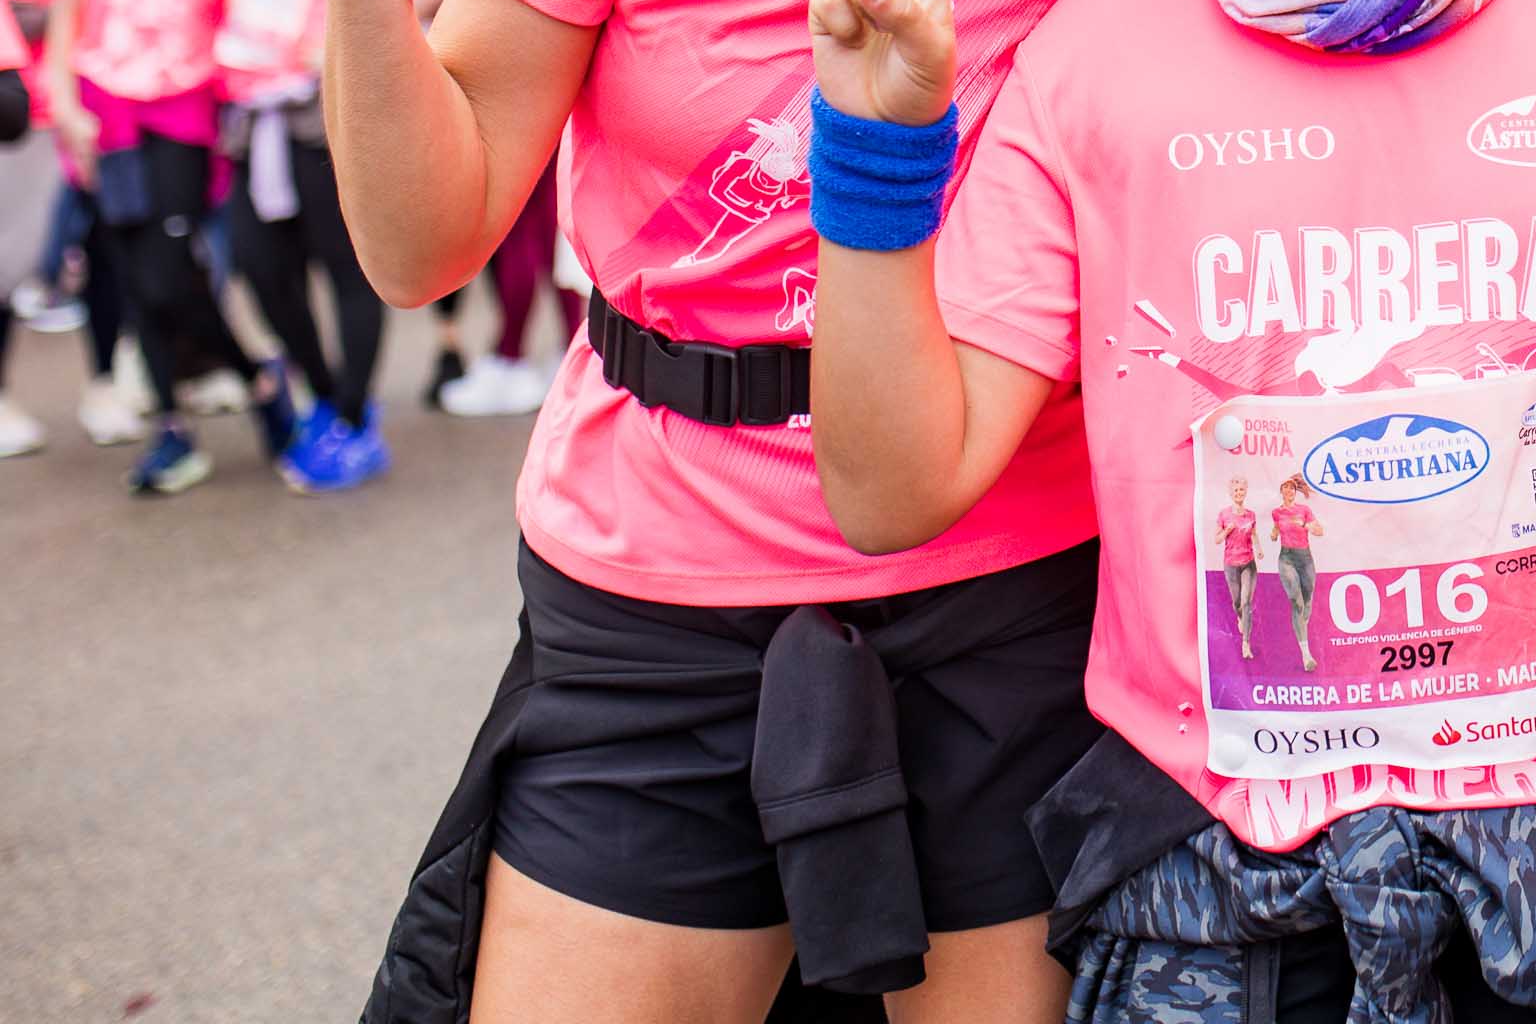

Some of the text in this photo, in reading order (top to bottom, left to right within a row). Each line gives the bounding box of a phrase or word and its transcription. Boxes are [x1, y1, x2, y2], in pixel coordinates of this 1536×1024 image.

[1167, 125, 1336, 170] OYSHO
[1245, 419, 1293, 433] DORSAL
[1319, 448, 1479, 485] ASTURIANA
[1345, 444, 1407, 457] CENTRAL
[1328, 562, 1489, 634] 016
[1380, 630, 1430, 642] VIOLENCIA
[1431, 629, 1443, 638] DE
[1379, 640, 1455, 673] 2997
[1252, 684, 1340, 706] CARRERA
[1347, 684, 1373, 703] DE
[1378, 681, 1406, 701] LA
[1411, 673, 1480, 699] MUJER
[1253, 725, 1381, 756] OYSHO
